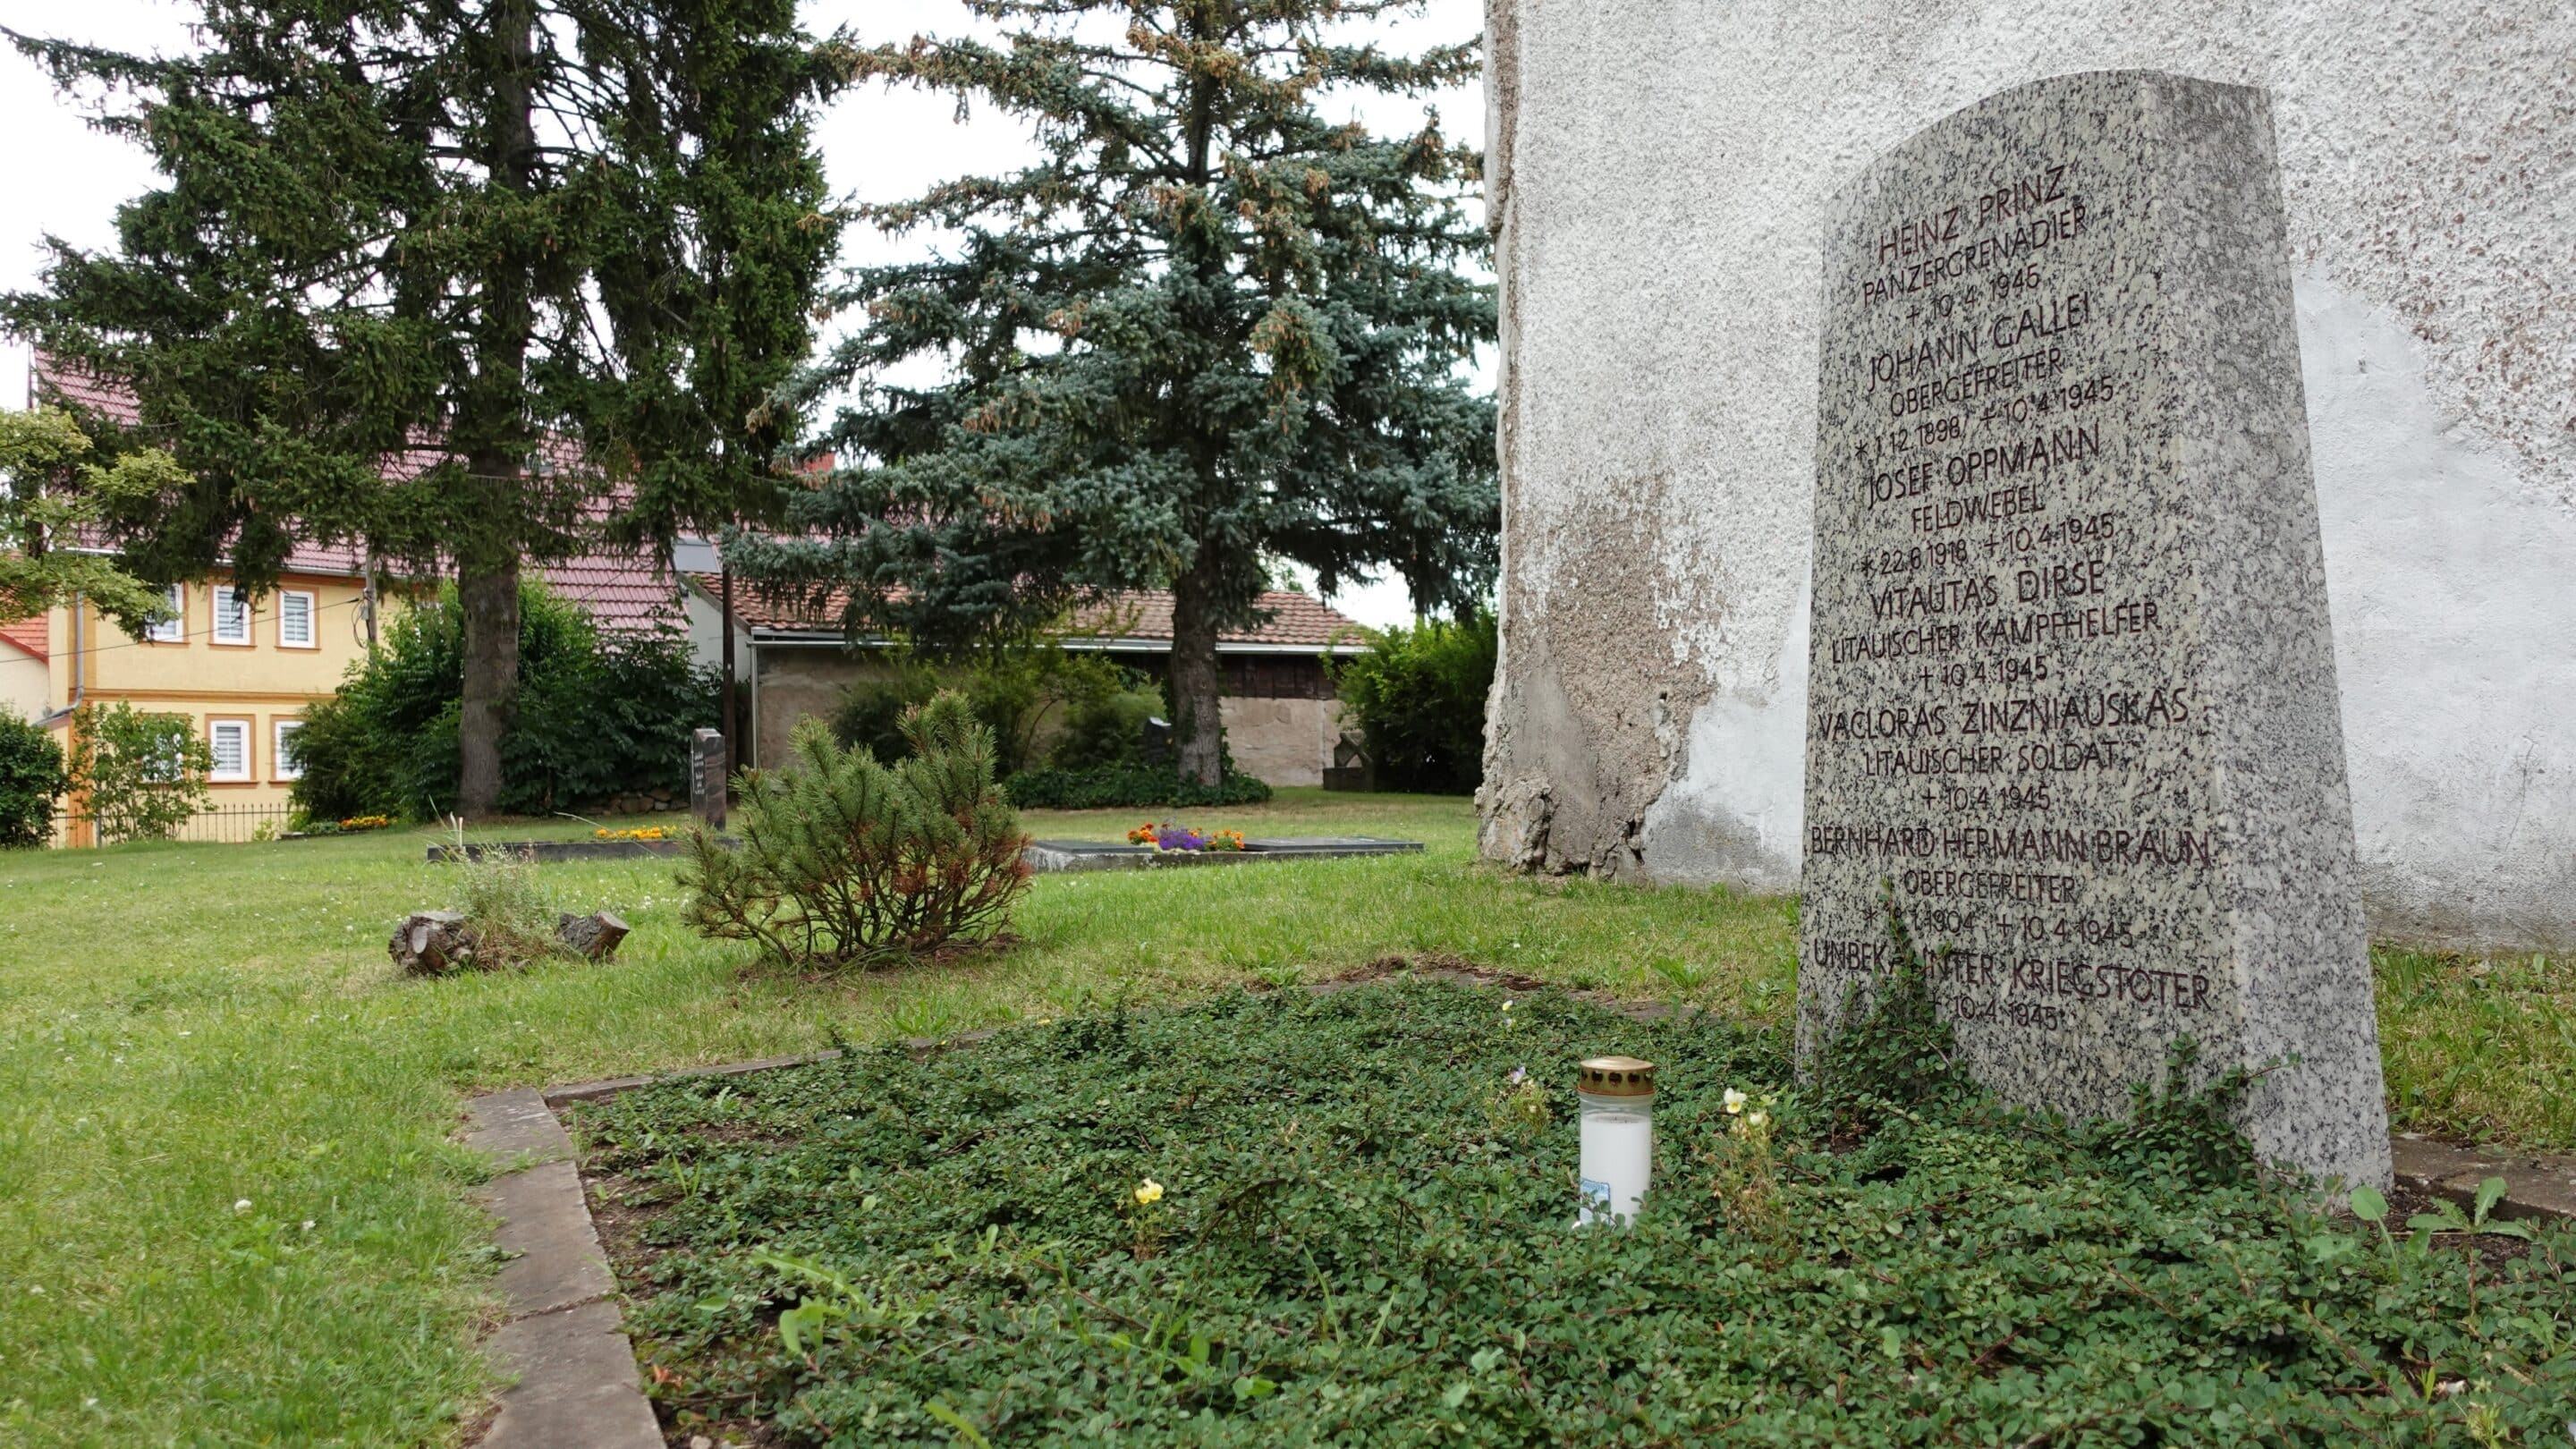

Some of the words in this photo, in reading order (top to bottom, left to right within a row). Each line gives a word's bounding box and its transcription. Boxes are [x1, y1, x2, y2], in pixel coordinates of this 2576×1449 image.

[1878, 208, 1960, 264] HEINZ
[1979, 165, 2065, 227] PRINZ
[1862, 205, 2087, 307] PANZERGRENADIER
[1868, 326, 1979, 393] JOHANN
[1993, 292, 2089, 349] GALLEI
[1890, 347, 2063, 418] OBERGEFREITER
[1867, 463, 1934, 512] JOSEF
[1947, 423, 2101, 487] OPPMANN
[1912, 487, 2046, 534] FELDWEBEL
[1871, 576, 1998, 621] VITAUTAS
[2019, 560, 2105, 603] DIRSE
[1833, 624, 1961, 664] LITAUISCHER
[1975, 602, 2162, 648] KAMPFHELFER
[1818, 705, 1946, 741] VACLORAS
[1962, 687, 2190, 733] ZINZNIAUSKAS
[1864, 747, 2003, 776] LITAUISCHER
[2018, 741, 2118, 771] SOLDAT
[1811, 826, 1935, 857] BERNHARD
[1944, 826, 2088, 862] HERMANN
[2097, 829, 2210, 868] BRAUN
[1903, 869, 2080, 903] OBERGEFREITER
[2012, 957, 2212, 1011] KRIEGSTOTER
